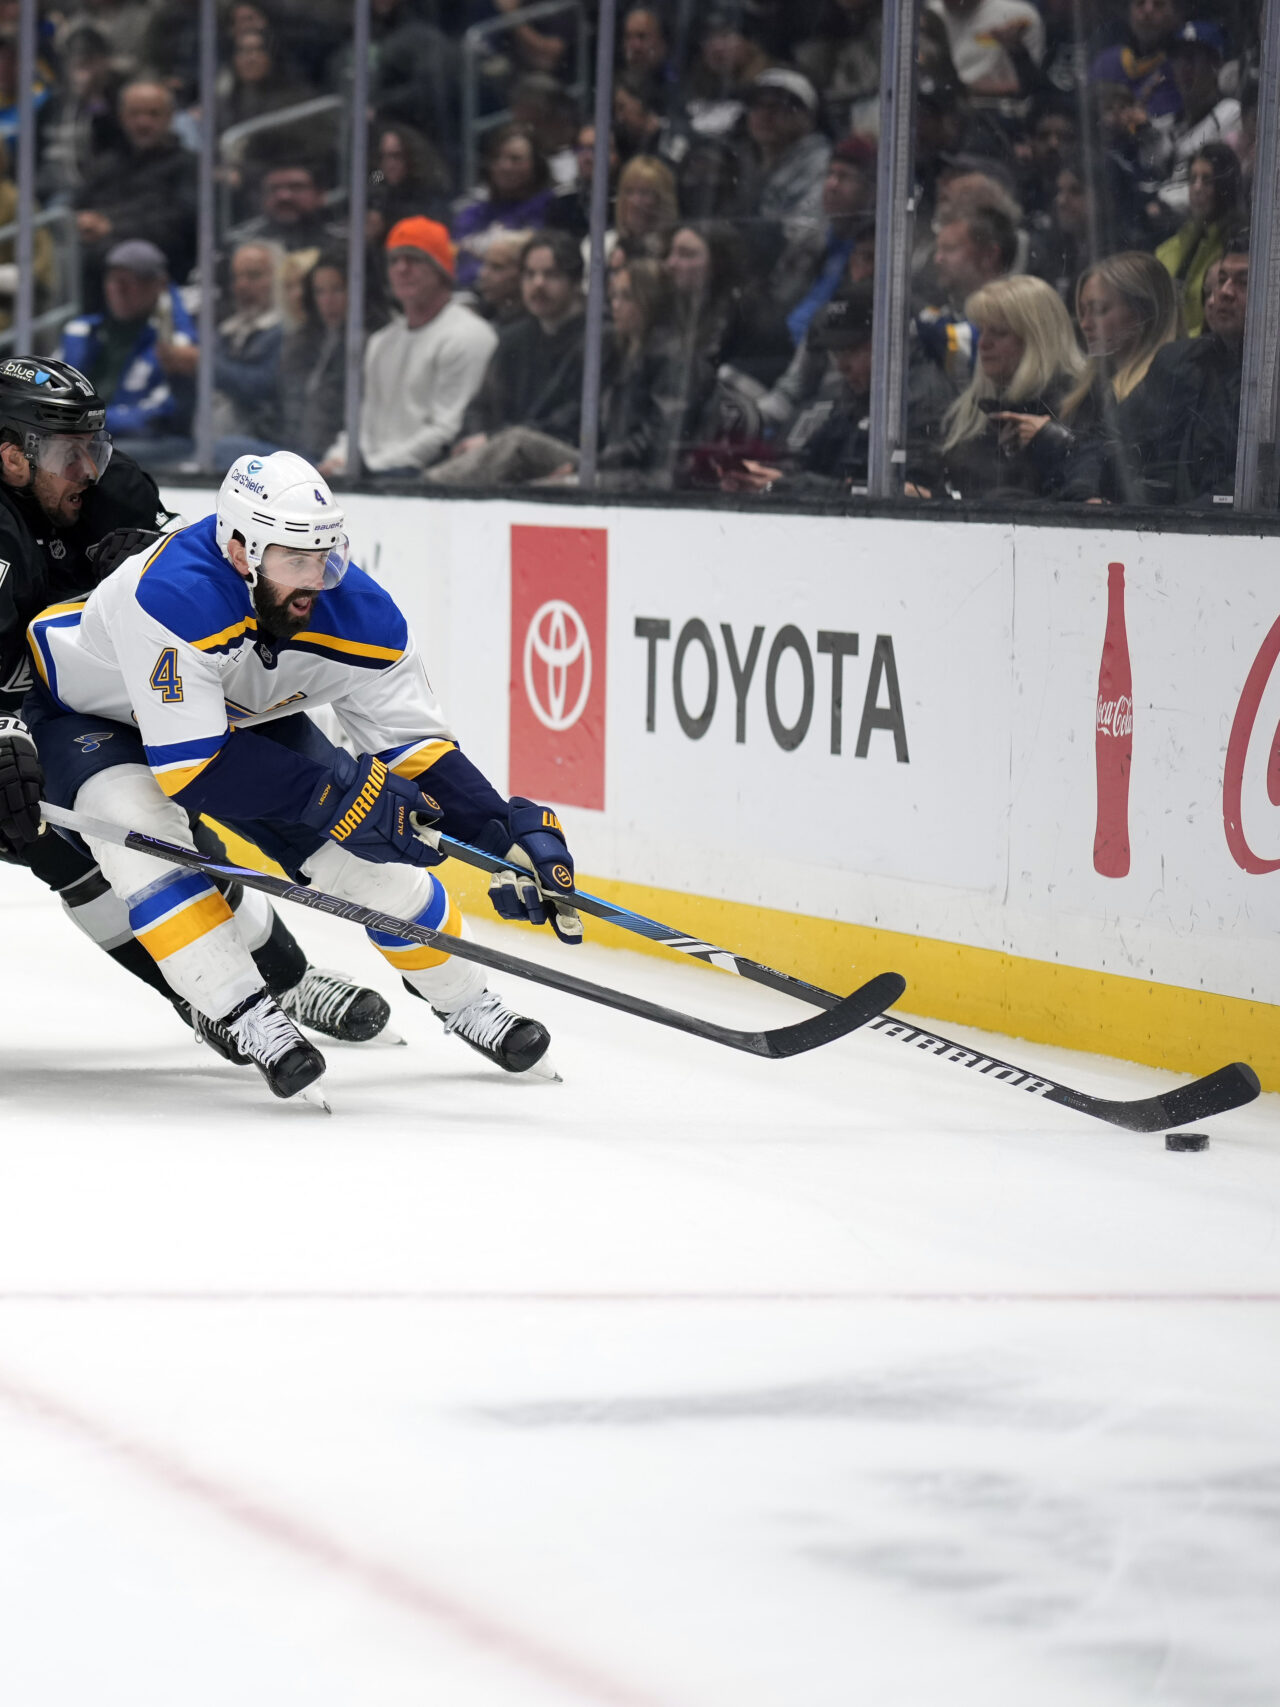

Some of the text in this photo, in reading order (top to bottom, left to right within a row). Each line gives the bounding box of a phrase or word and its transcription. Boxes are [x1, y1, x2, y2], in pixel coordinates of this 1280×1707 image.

[6, 362, 35, 379] blue
[231, 468, 265, 494] CarShield
[314, 489, 327, 506] 4
[149, 647, 184, 703] 4
[634, 616, 910, 764] TOYOTA
[329, 756, 388, 842] WARRIOR
[397, 806, 405, 836] ALPHA
[868, 1016, 1057, 1099] ARRIOR
